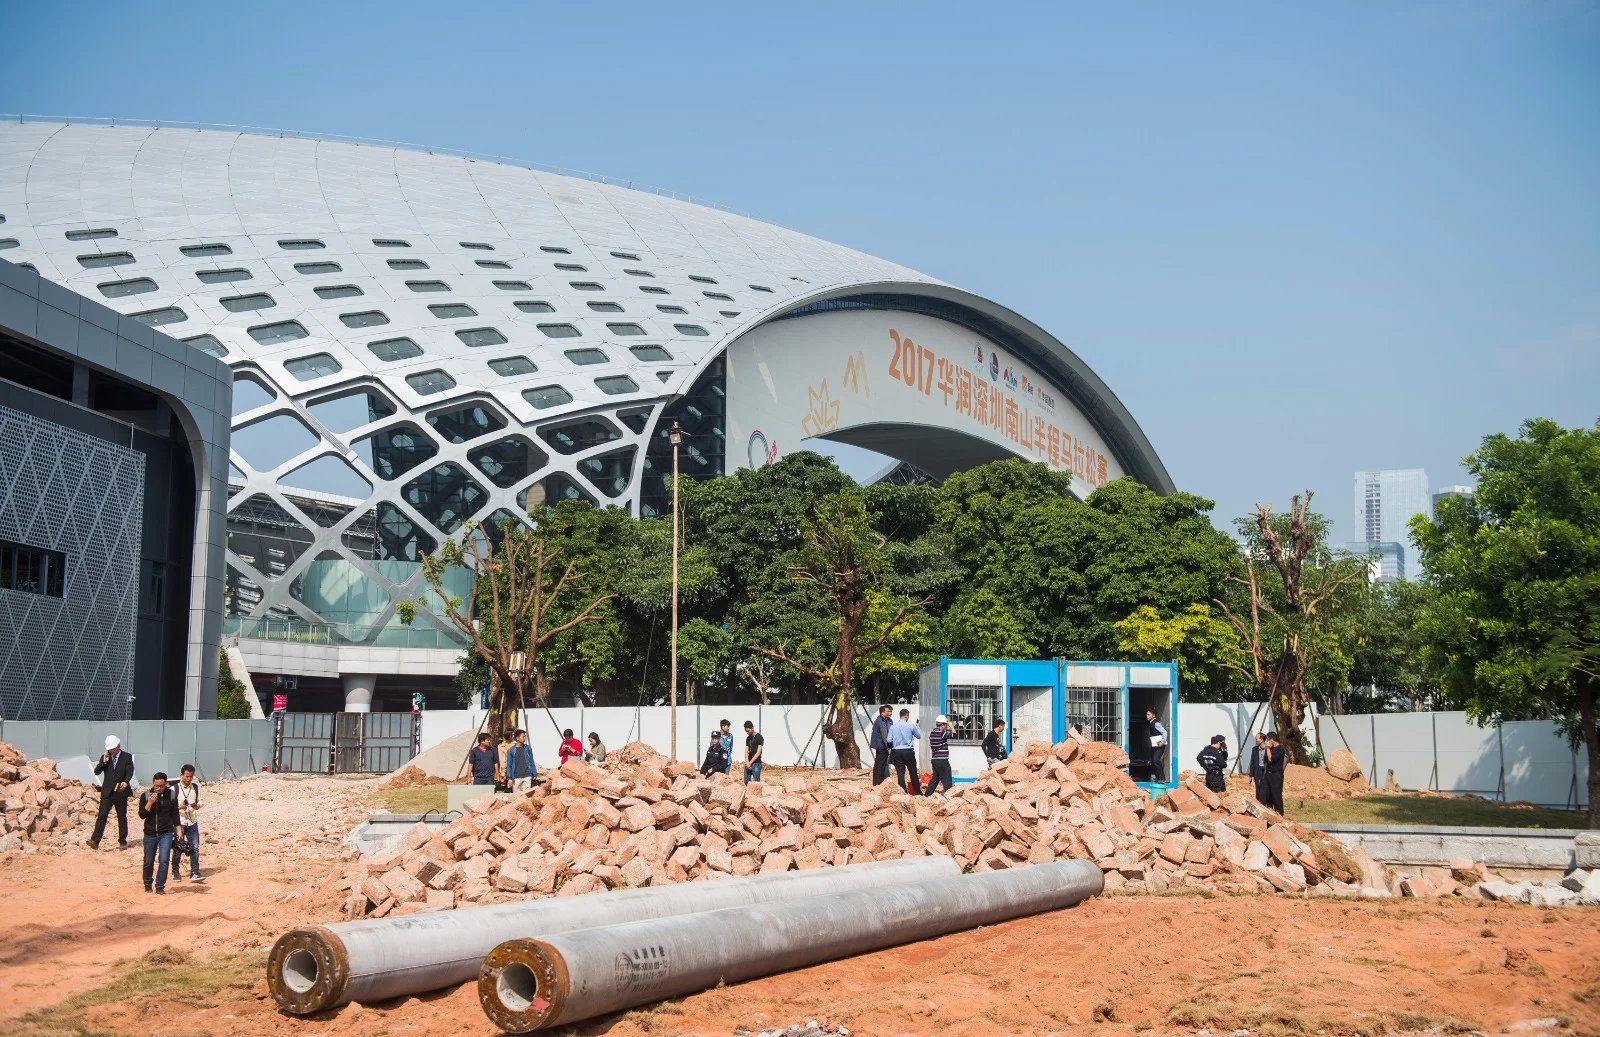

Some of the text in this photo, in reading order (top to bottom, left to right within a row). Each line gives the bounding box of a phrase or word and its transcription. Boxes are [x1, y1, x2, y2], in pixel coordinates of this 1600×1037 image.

[888, 328, 1108, 489] 2017华润深圳南山半程马拉松赛
